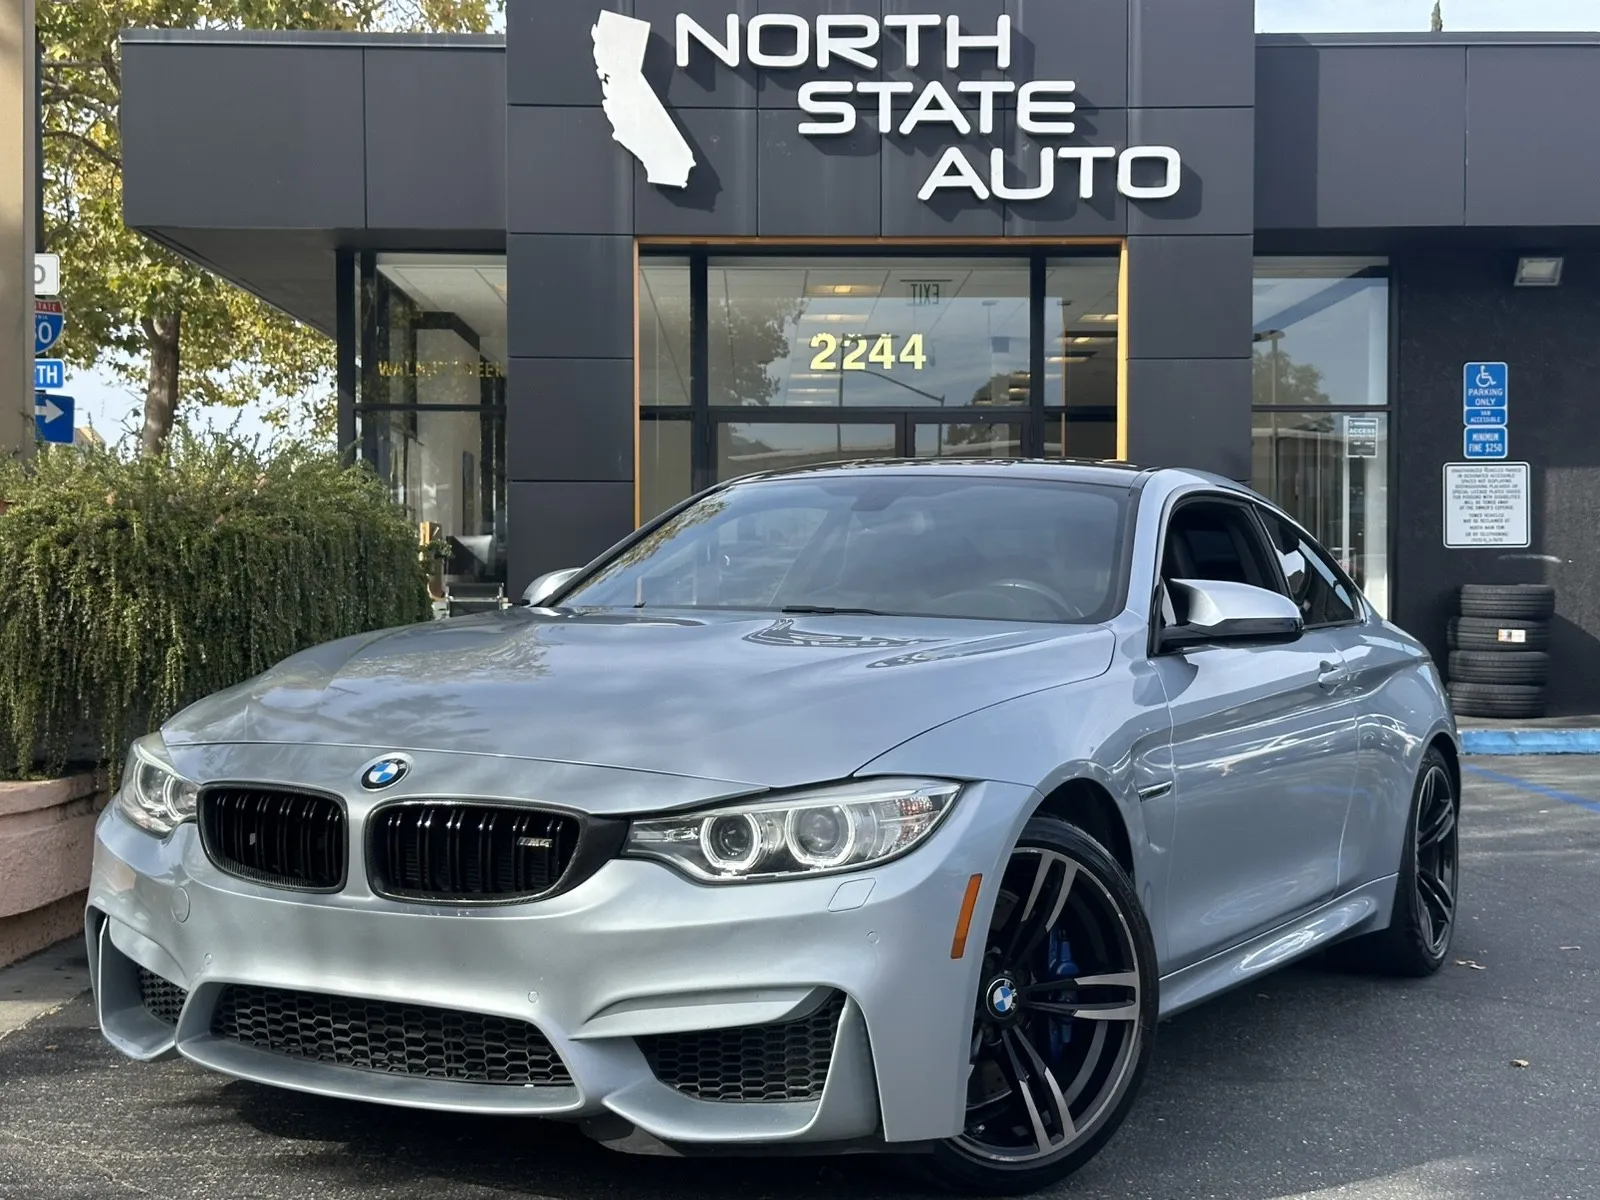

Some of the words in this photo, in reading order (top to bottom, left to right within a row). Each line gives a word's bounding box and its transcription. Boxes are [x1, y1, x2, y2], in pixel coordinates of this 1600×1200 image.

[675, 13, 1011, 69] NORTH
[797, 80, 1077, 135] STATE
[917, 145, 1182, 201] AUTO
[809, 332, 927, 370] 2244
[1468, 388, 1503, 396] PARKING
[1474, 398, 1496, 406] ONLY
[1468, 443, 1483, 452] FINE
